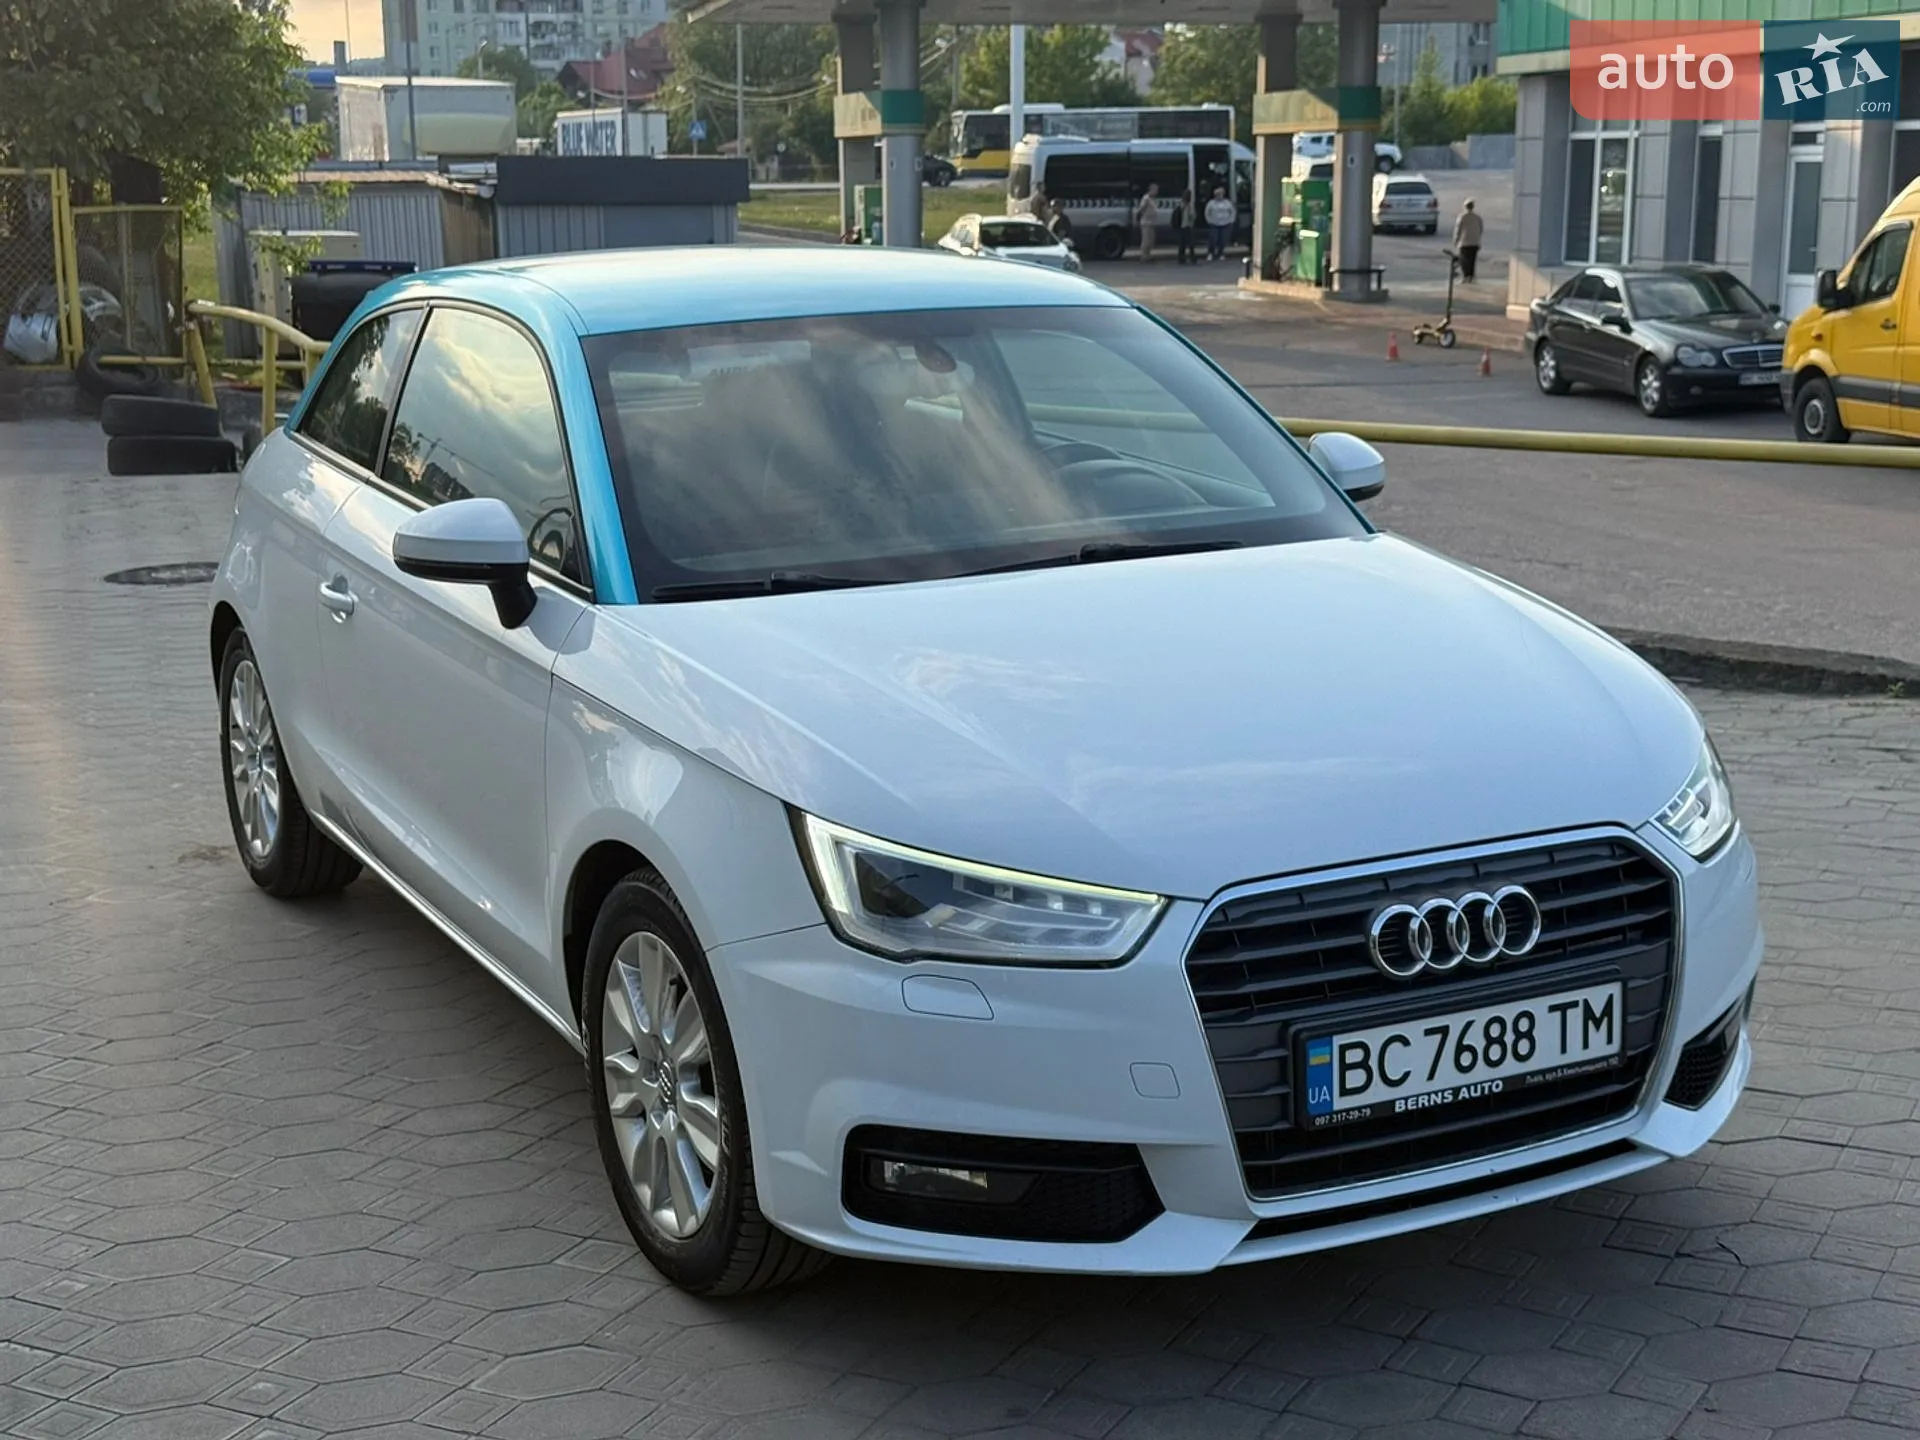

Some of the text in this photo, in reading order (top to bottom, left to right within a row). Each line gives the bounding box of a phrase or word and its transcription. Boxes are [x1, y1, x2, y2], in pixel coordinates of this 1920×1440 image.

[1338, 1034, 1412, 1098] BC
[1424, 1010, 1536, 1081] 7688
[1548, 993, 1614, 1055] TM
[1309, 1085, 1331, 1104] UA
[1394, 1080, 1504, 1113] BERNS AUTO
